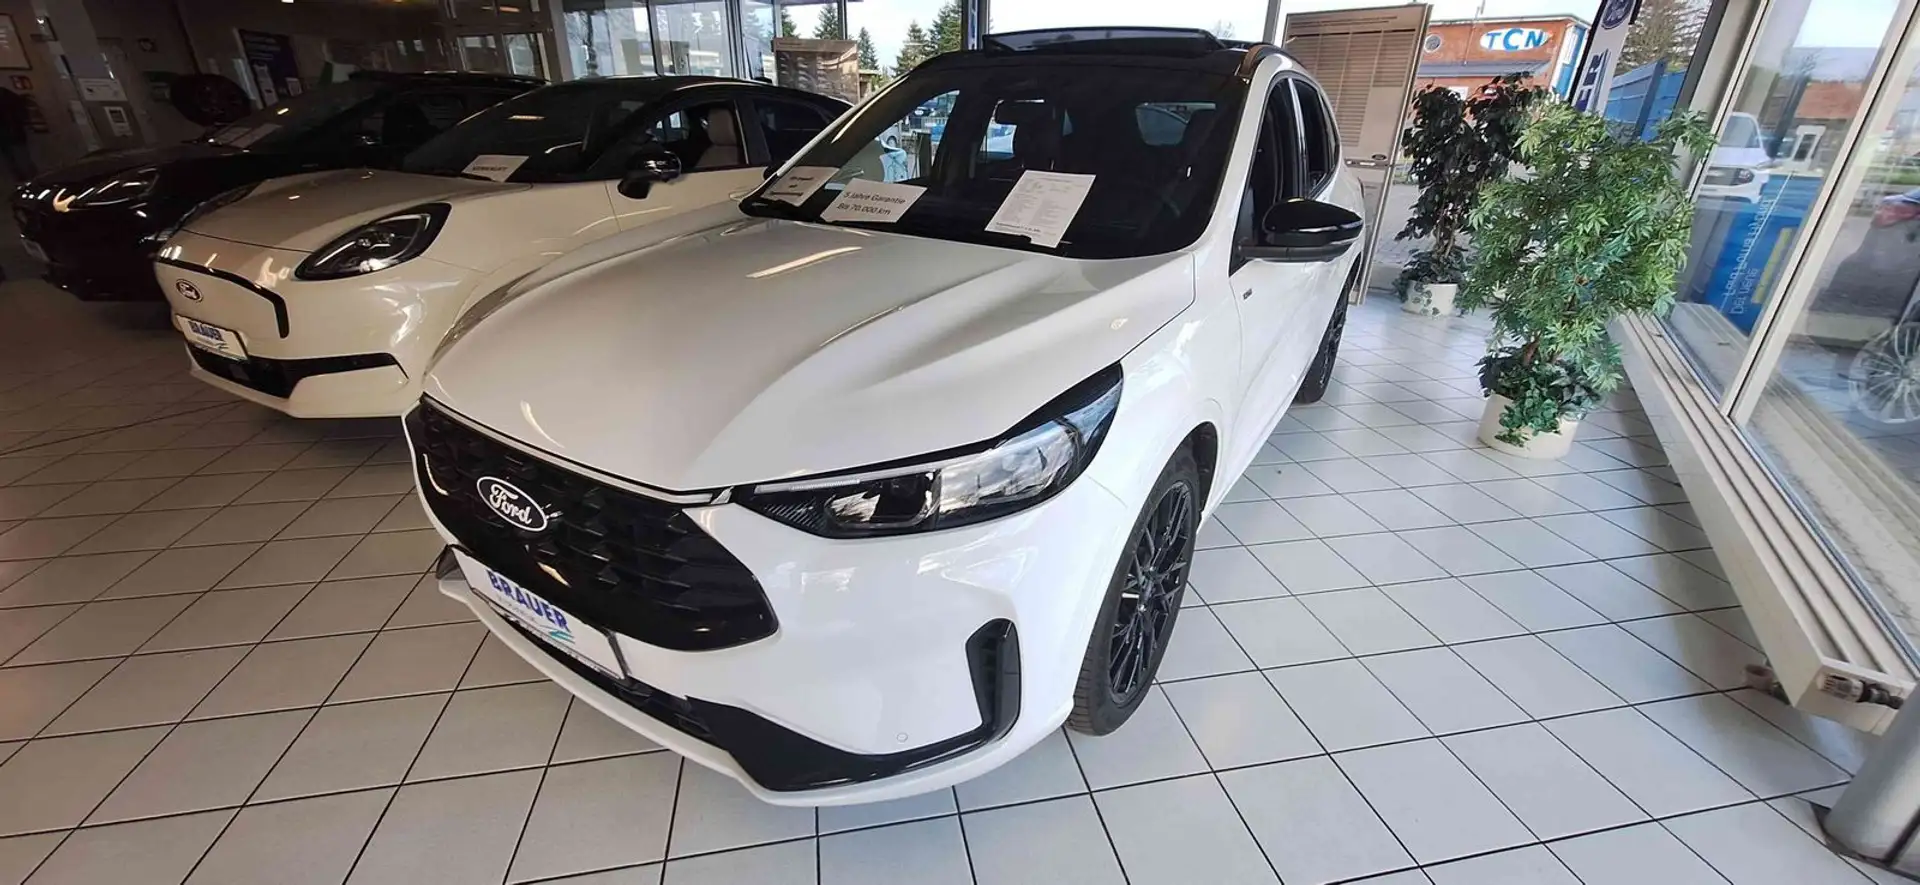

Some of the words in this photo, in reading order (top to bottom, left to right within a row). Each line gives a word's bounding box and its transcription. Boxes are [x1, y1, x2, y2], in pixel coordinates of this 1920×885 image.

[1485, 28, 1544, 51] TCN
[851, 192, 870, 200] Jahre
[871, 194, 906, 204] Garantie
[878, 207, 891, 215] km
[490, 483, 532, 524] Ford
[486, 569, 572, 634] BRAUER
